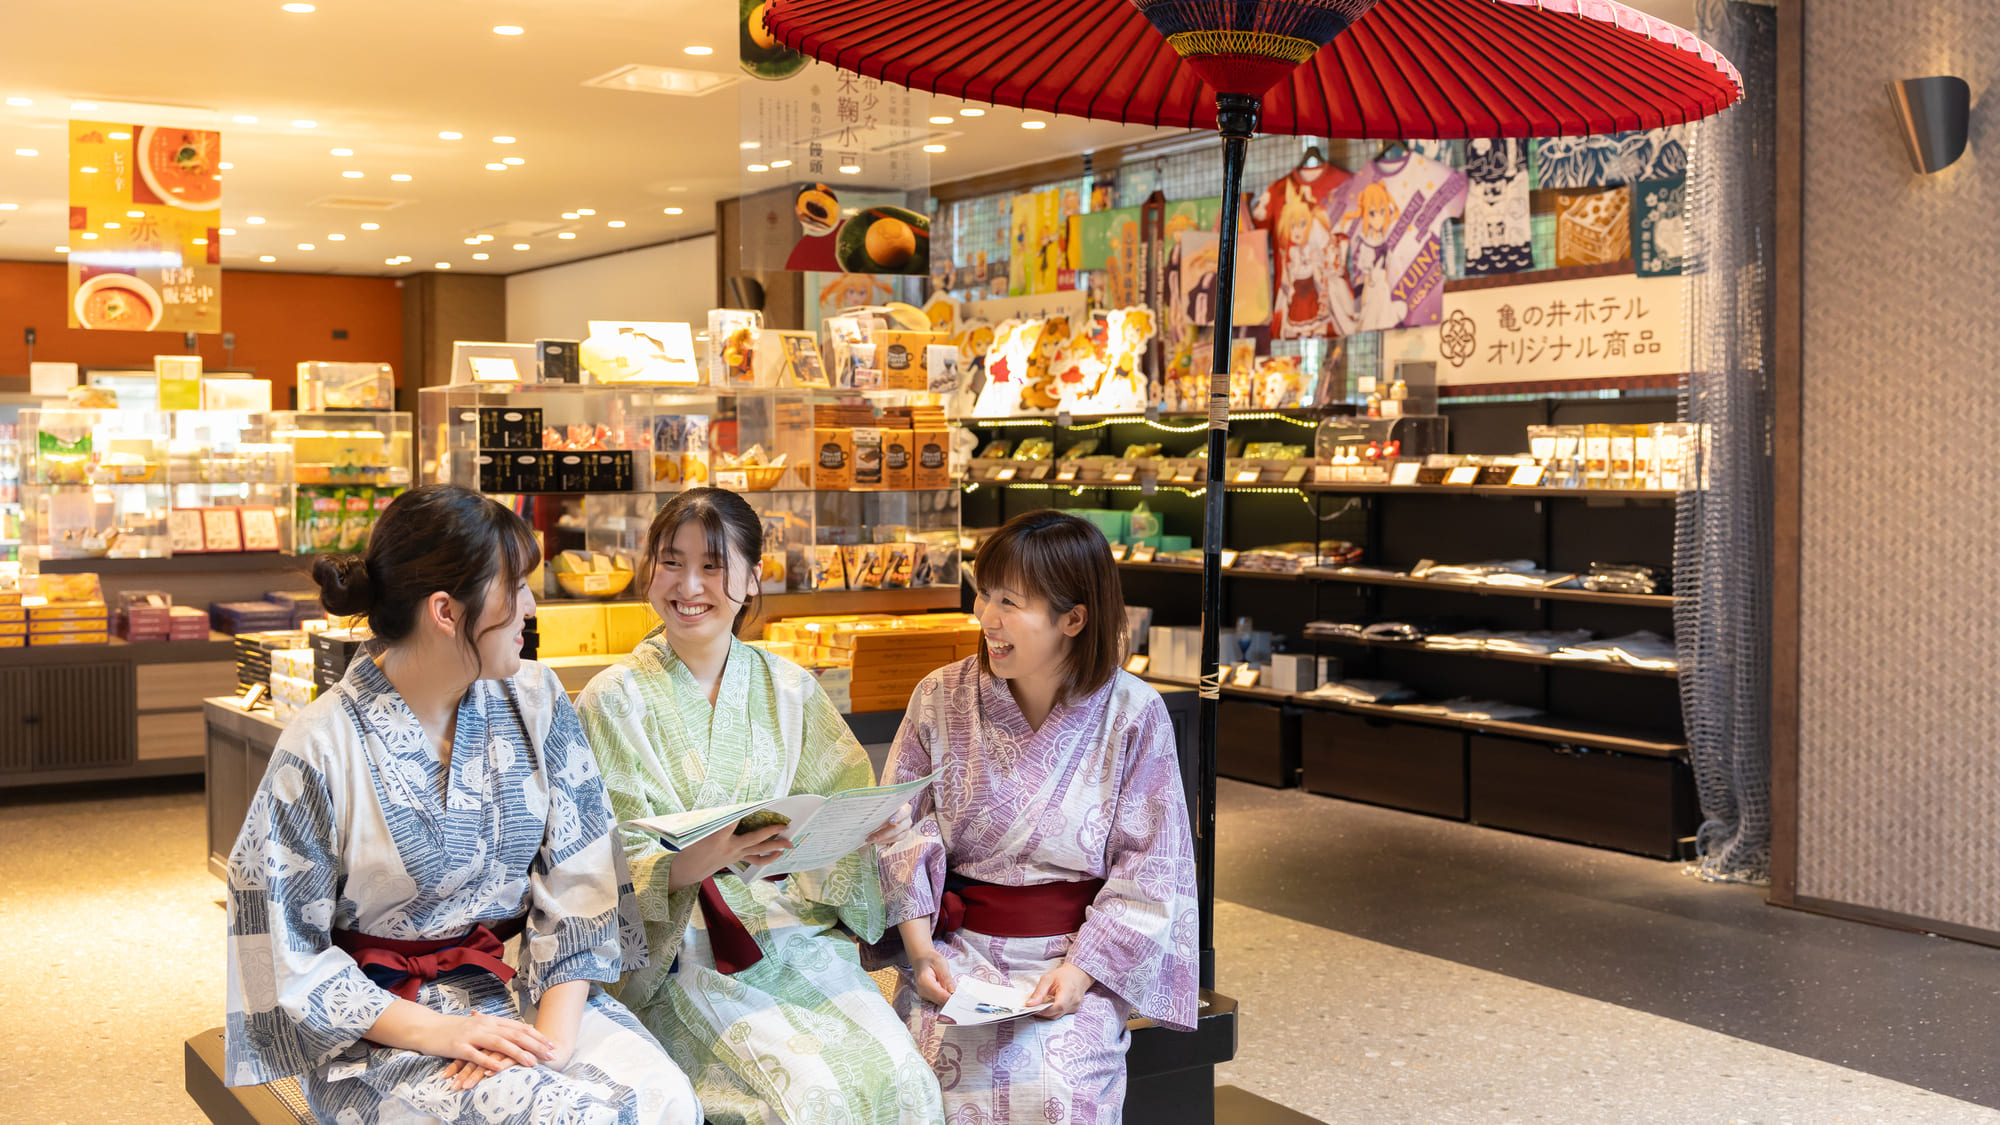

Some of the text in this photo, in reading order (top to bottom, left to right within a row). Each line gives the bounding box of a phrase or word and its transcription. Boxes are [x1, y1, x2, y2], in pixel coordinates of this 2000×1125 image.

[161, 267, 195, 285] 好評
[1393, 240, 1441, 300] YUINA
[162, 285, 214, 304] 販売中
[1497, 296, 1649, 332] 亀の井ホテル
[1487, 329, 1661, 365] オリジナル商品
